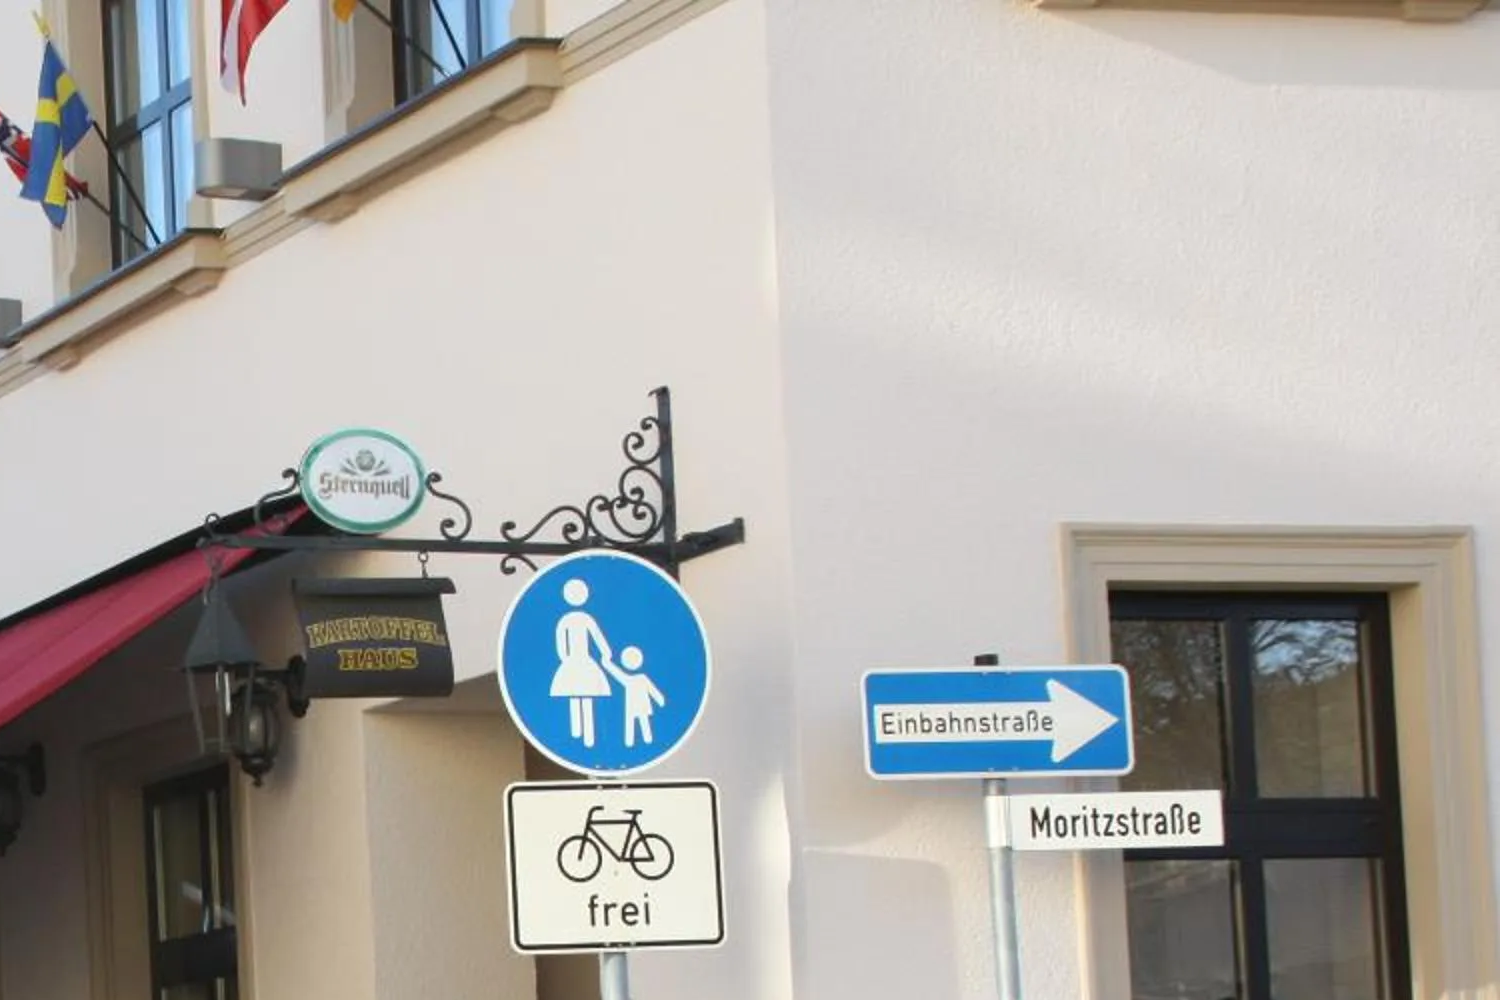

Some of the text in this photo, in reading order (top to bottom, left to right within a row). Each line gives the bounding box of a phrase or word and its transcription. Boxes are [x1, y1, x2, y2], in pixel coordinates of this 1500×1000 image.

[319, 472, 411, 500] Sternquell
[305, 615, 447, 649] KARTOFFEL
[337, 647, 418, 671] HAUS
[880, 710, 1054, 736] Einbahnstraße
[1030, 803, 1202, 839] Moritzstraße
[588, 893, 651, 927] frei
